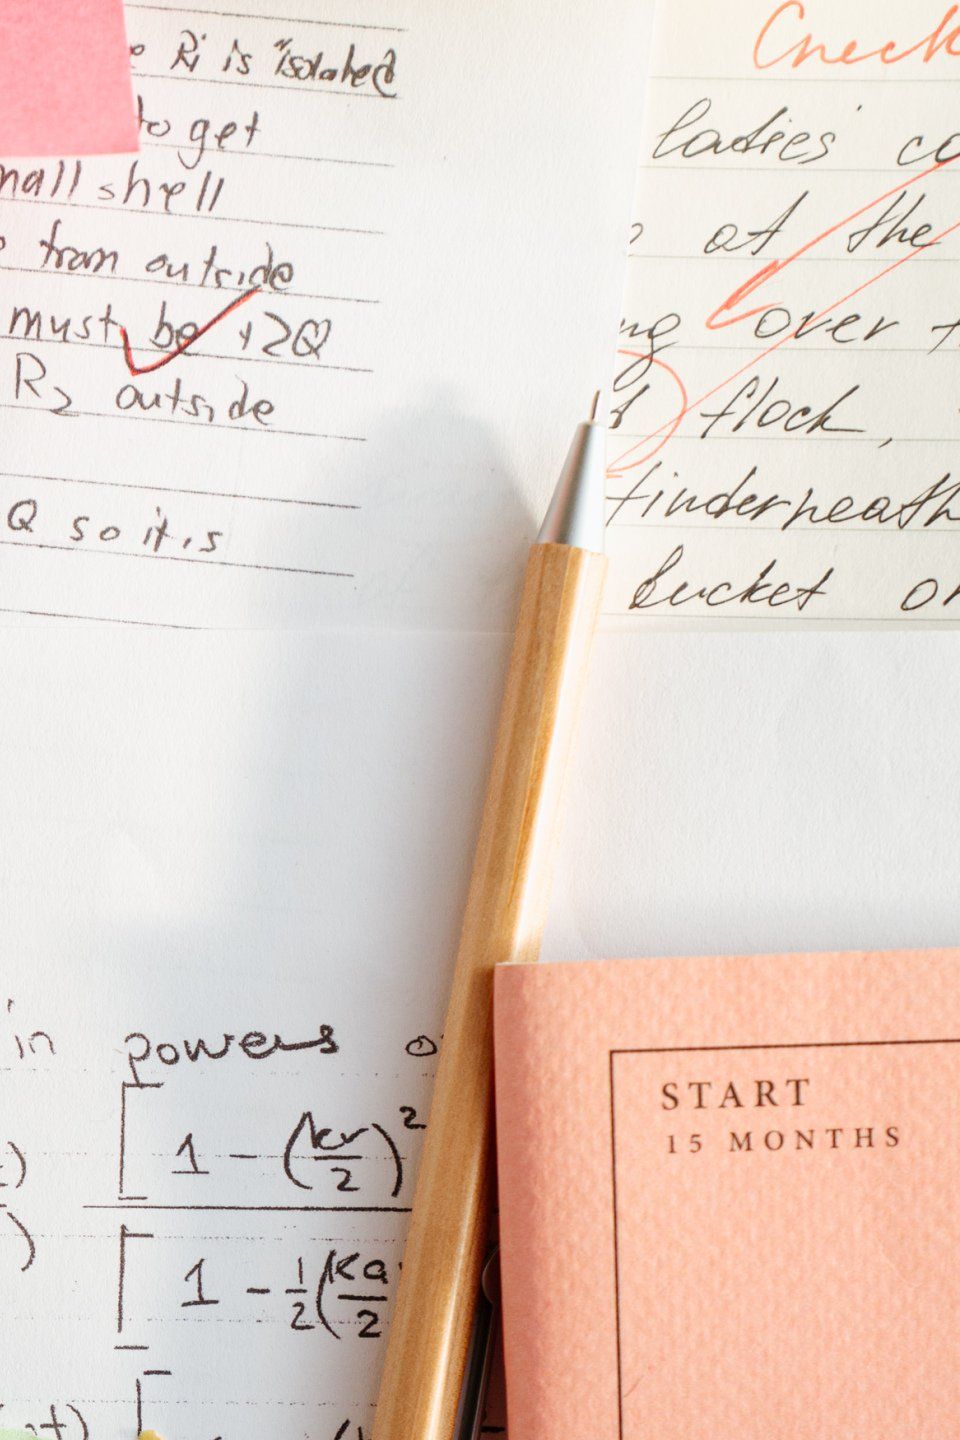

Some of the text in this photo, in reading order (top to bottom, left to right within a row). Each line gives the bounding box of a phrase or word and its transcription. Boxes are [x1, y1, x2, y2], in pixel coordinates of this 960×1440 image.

[222, 39, 252, 75] is
[137, 95, 261, 169] to get
[98, 169, 227, 213] shell
[703, 190, 942, 255] at the
[40, 220, 119, 275] from
[145, 243, 296, 290] outside
[9, 303, 118, 343] must
[154, 300, 199, 348] be
[754, 308, 900, 343] over
[115, 376, 275, 426] outside
[69, 513, 121, 545] so
[629, 544, 835, 610] bucket
[7, 997, 55, 1060] in
[124, 1023, 340, 1086] powers
[661, 1078, 811, 1111] START
[667, 1126, 902, 1155] 15 MONTHS
